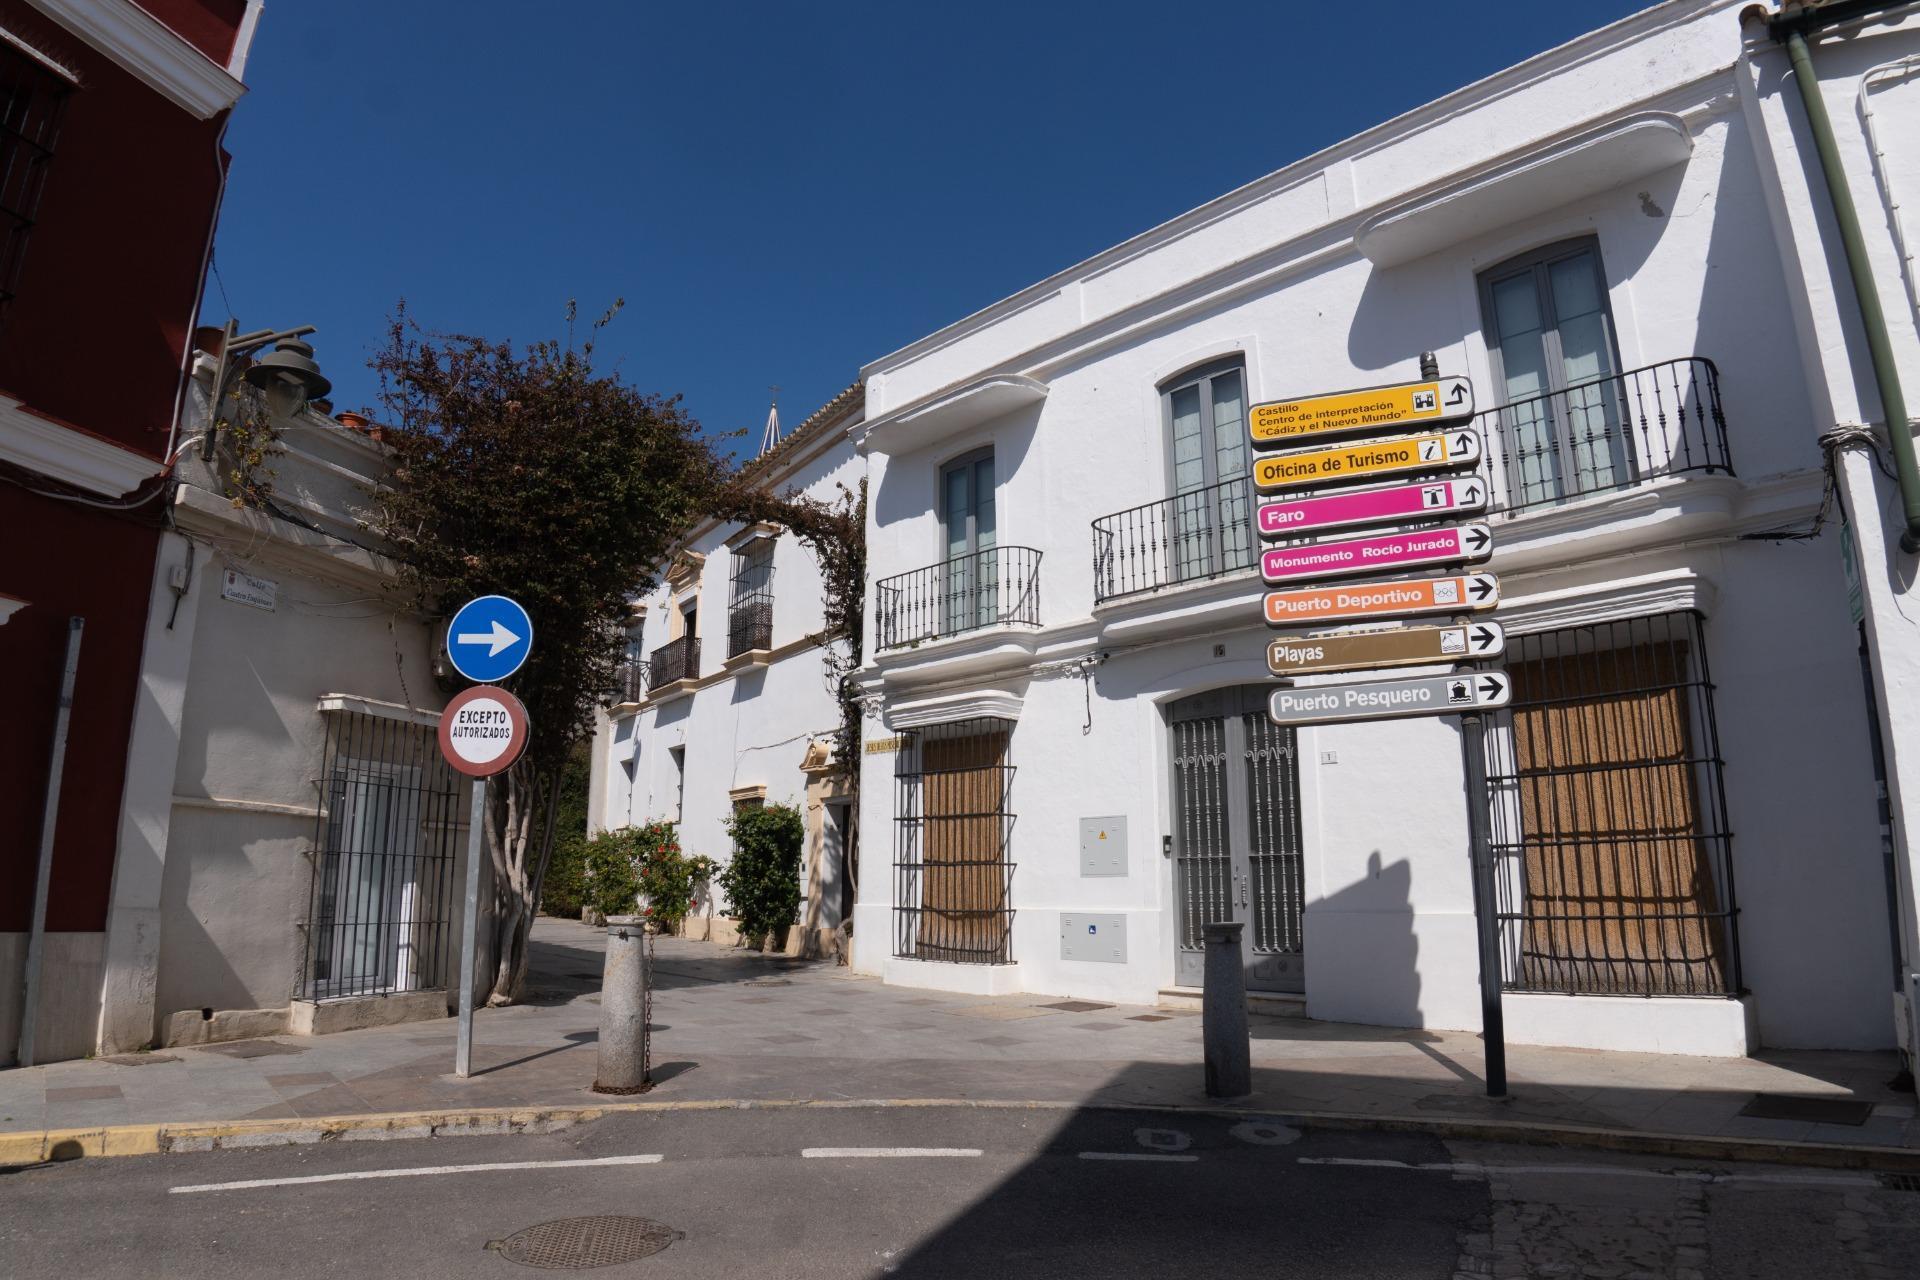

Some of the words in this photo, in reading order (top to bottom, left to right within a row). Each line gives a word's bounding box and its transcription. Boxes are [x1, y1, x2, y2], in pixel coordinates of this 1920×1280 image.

[1258, 405, 1299, 416] Castillo
[1259, 416, 1295, 426] Centro
[1299, 413, 1312, 421] de
[1300, 425, 1306, 433] y
[1309, 421, 1319, 430] el
[1323, 417, 1358, 428] Nuevo
[1264, 463, 1317, 480] Oficina
[1322, 458, 1342, 472] de
[1346, 450, 1409, 469] Turismo
[1267, 510, 1305, 525] Faro
[1270, 551, 1354, 570] Monumento
[1407, 538, 1455, 553] Jurado
[1275, 597, 1332, 614] Puerto
[1337, 589, 1423, 609] Deportivo
[1274, 646, 1325, 665] Playas
[1280, 693, 1339, 713] Puerto
[1345, 687, 1432, 709] Pesquero
[459, 710, 506, 724] EXCEPTO
[452, 726, 510, 739] AUTORIZADOS
